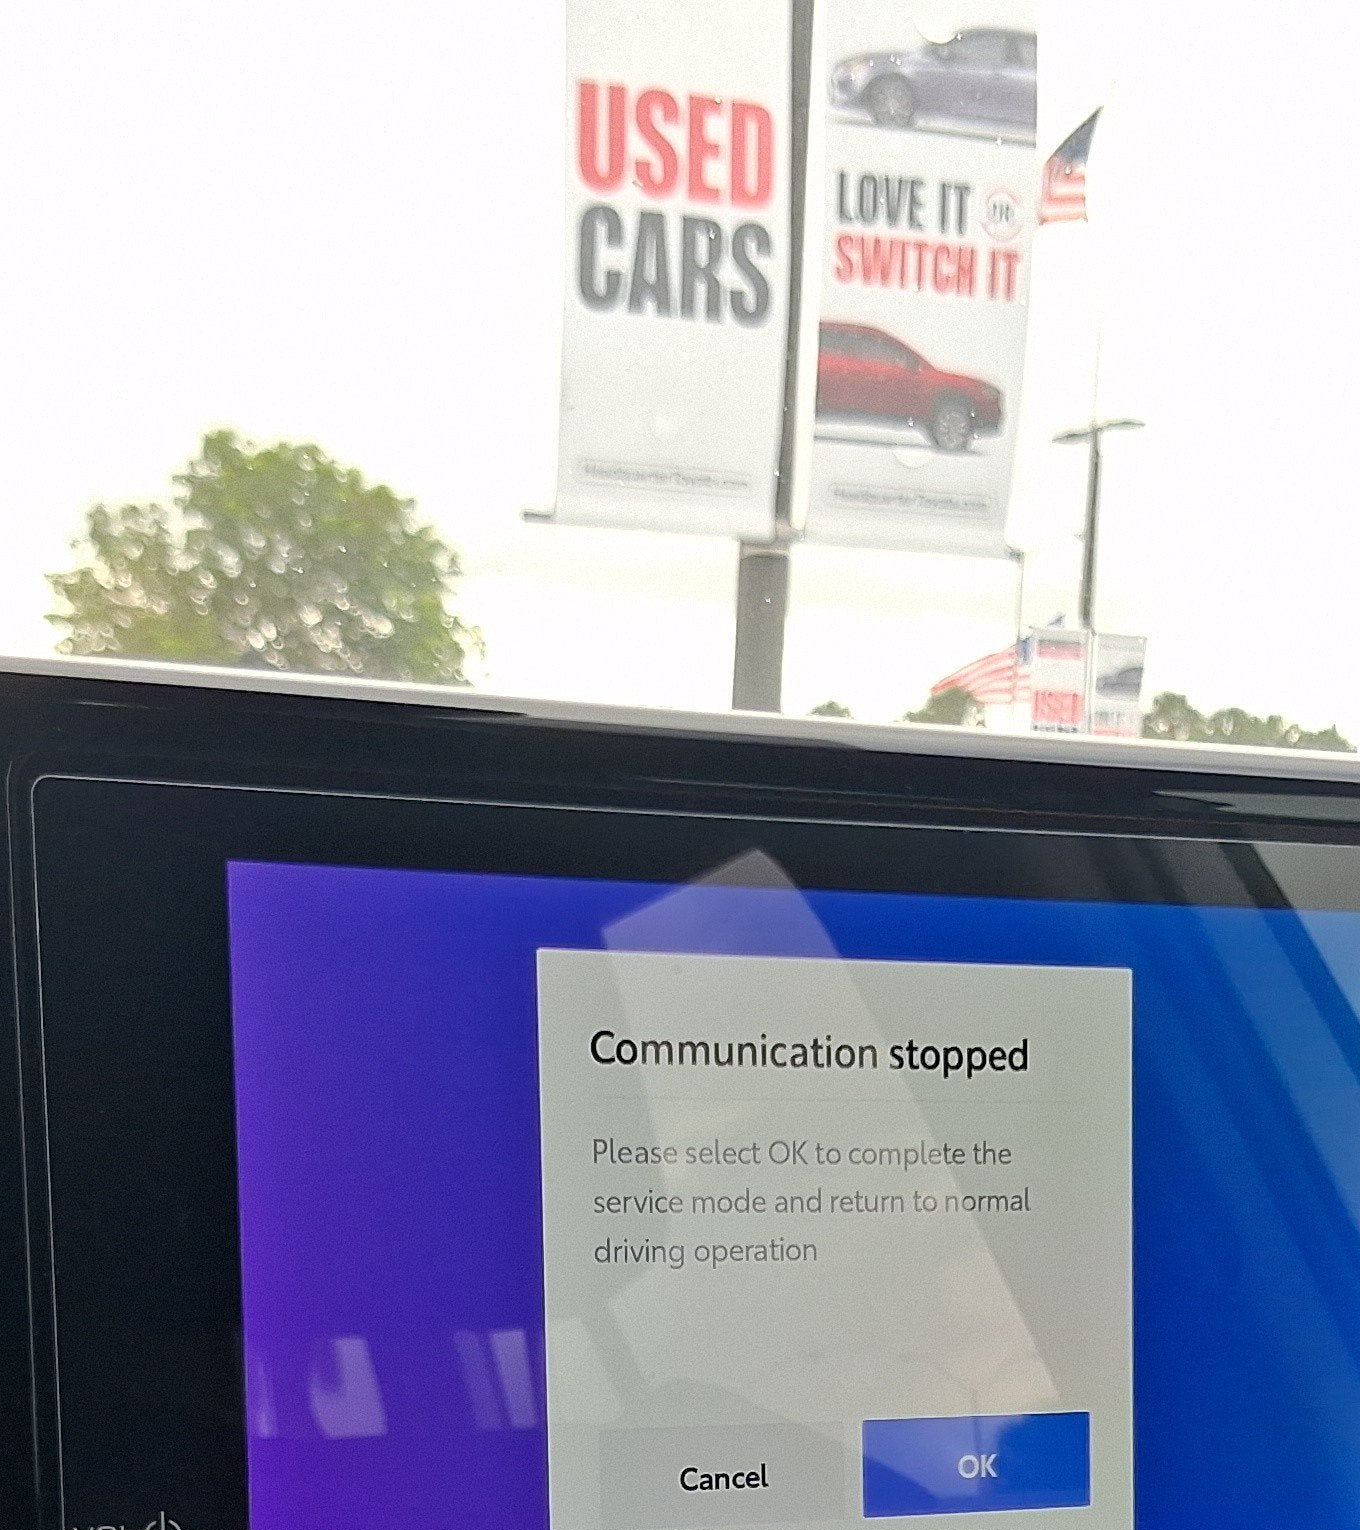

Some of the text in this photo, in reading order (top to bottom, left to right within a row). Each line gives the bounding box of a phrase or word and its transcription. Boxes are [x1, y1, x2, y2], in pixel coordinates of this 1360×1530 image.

[579, 82, 773, 208] USED
[837, 170, 974, 236] LOVE IT
[579, 205, 772, 327] CARS
[836, 235, 1020, 301] SWITCH IT
[590, 1030, 1030, 1080] Communication stopped
[592, 1138, 1012, 1172] Please select OK to complete the
[593, 1187, 1031, 1214] service mode and return to normal
[594, 1237, 818, 1269] driving operation
[679, 1462, 770, 1492] Cancel
[957, 1453, 999, 1480] OK
